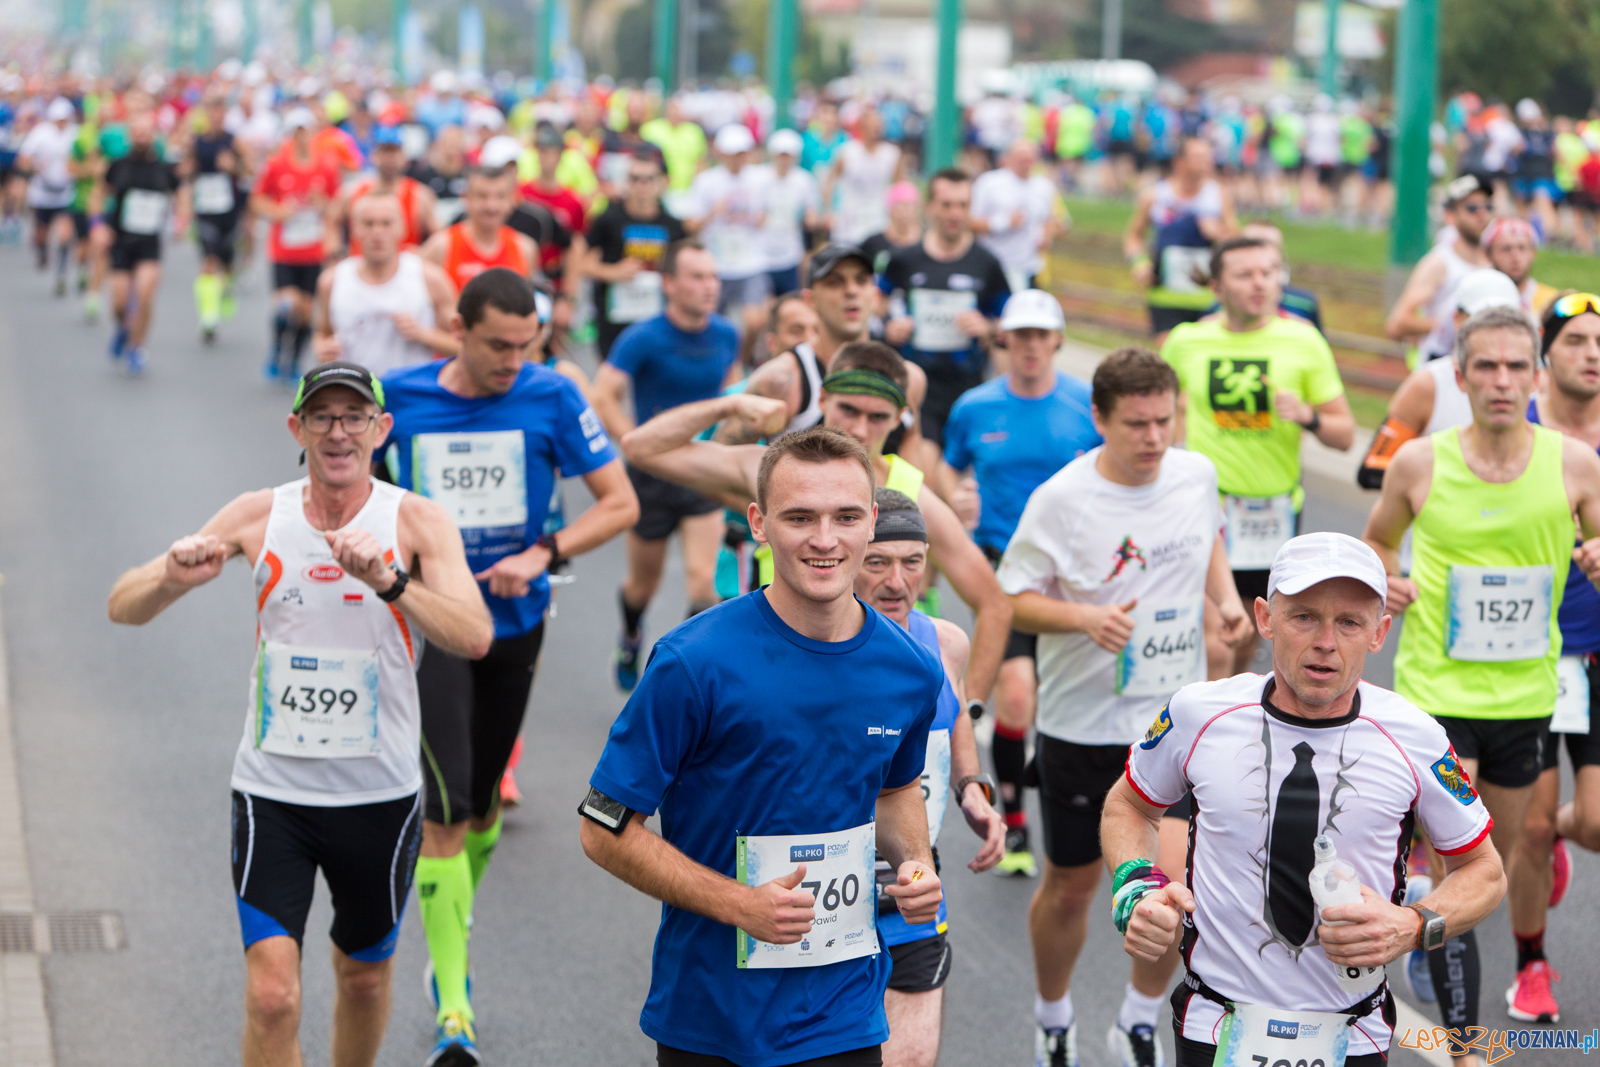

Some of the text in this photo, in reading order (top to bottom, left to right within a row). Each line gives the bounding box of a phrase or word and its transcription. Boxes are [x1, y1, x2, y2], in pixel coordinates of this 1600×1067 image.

[442, 465, 506, 490] 5879
[1475, 599, 1534, 622] 1527
[281, 685, 358, 714] 4399
[793, 849, 805, 858] 18.
[805, 848, 823, 857] PKO
[1270, 1024, 1280, 1033] 18.
[1280, 1026, 1297, 1035] PKO
